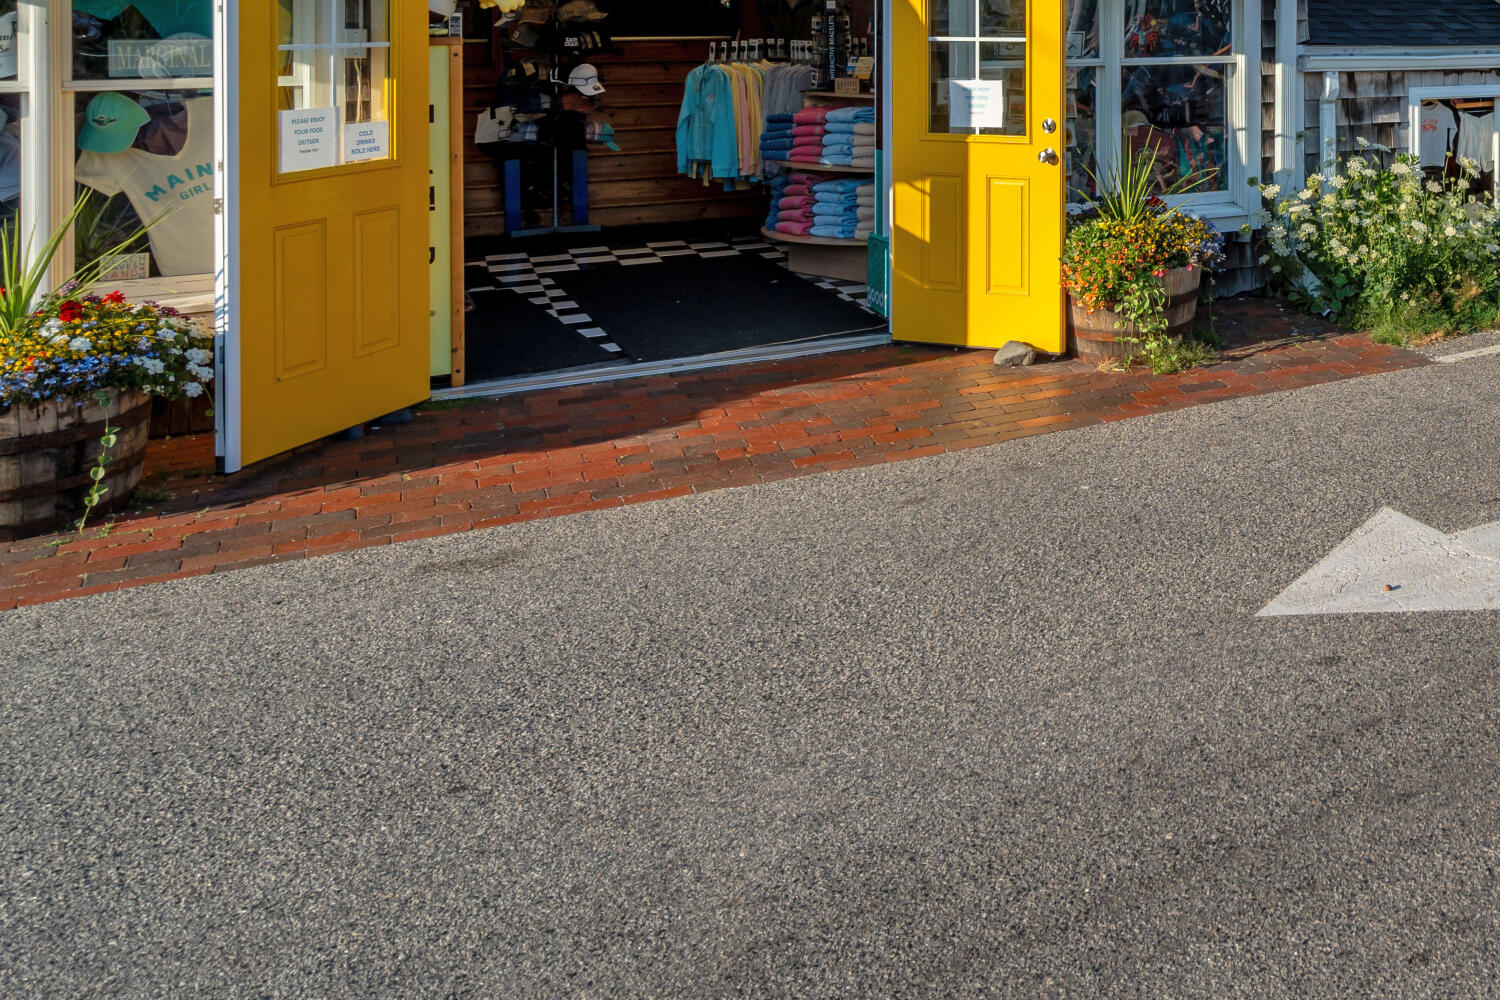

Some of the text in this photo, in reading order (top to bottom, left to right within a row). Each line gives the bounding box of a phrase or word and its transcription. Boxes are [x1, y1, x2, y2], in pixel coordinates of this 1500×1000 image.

[116, 44, 210, 70] MARGINAL
[291, 117, 309, 125] PLEASE
[358, 129, 374, 137] COLD
[297, 138, 320, 146] OUTSIDE
[356, 137, 376, 146] DRINKS
[366, 145, 381, 153] HERE
